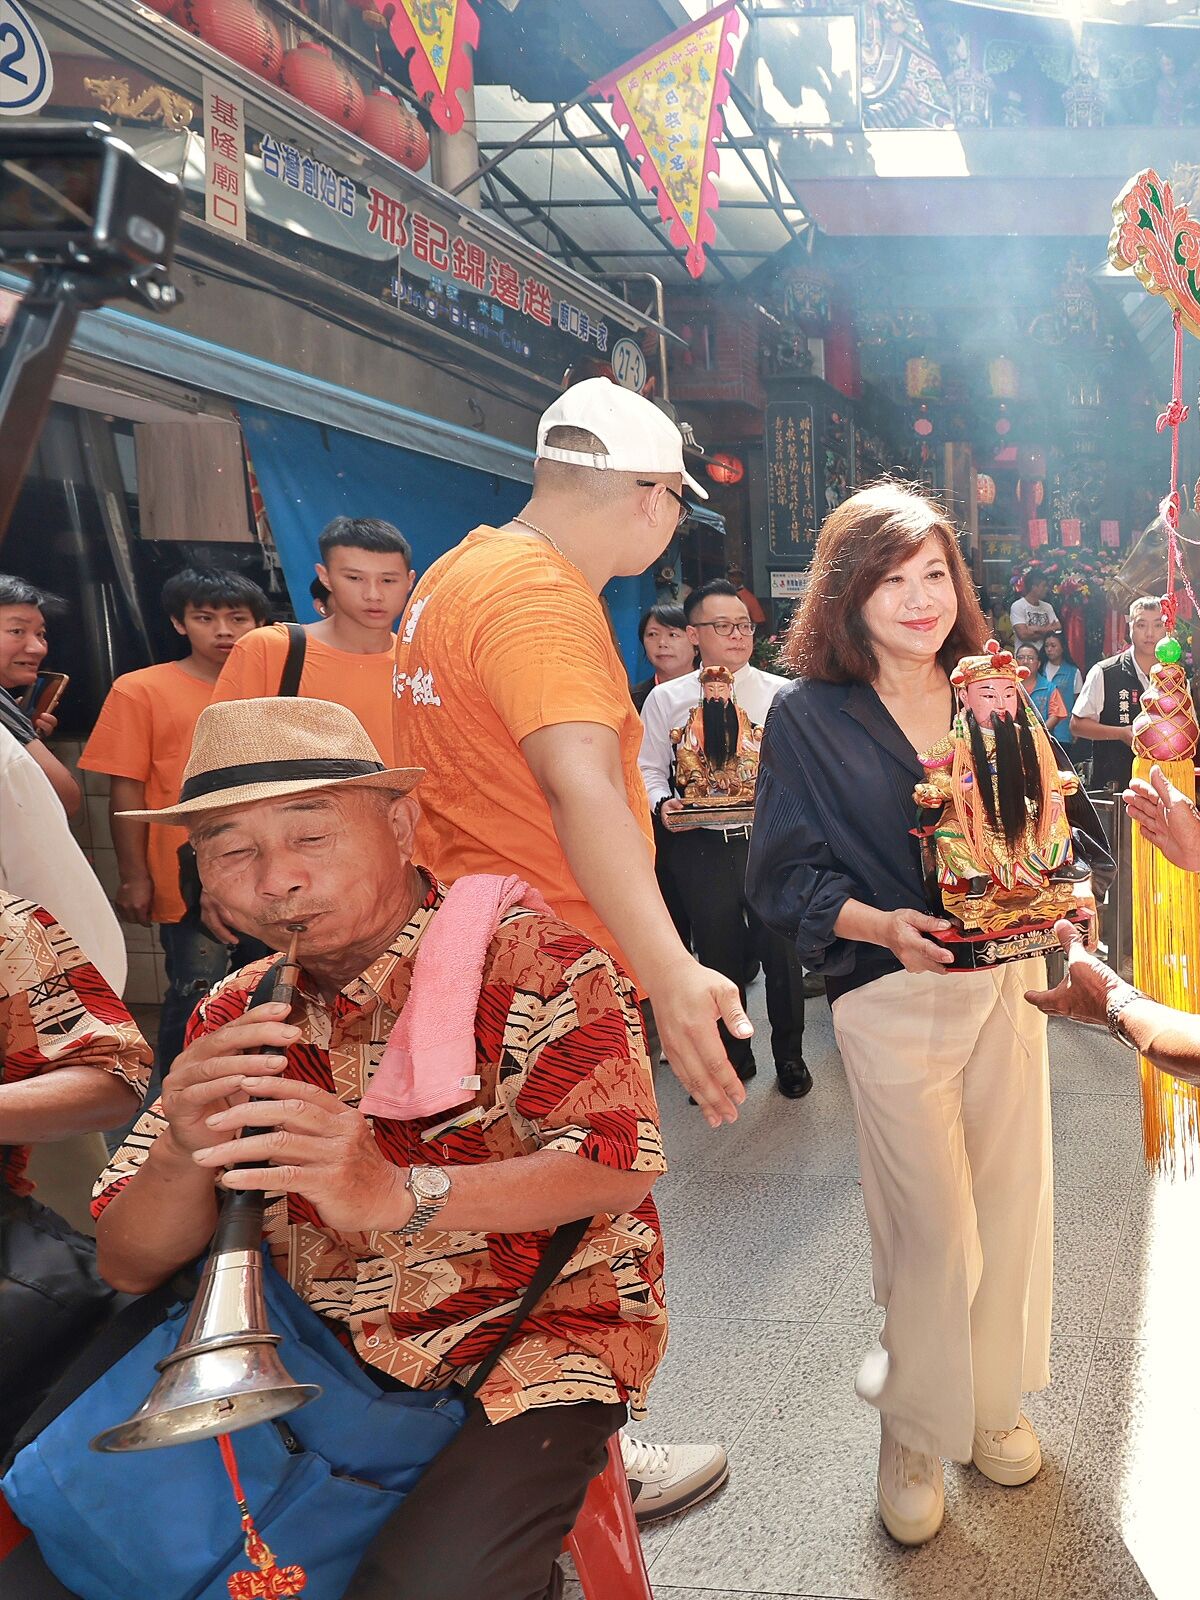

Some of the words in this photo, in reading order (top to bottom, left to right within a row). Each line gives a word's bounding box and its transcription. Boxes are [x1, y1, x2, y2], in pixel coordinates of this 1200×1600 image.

[210, 93, 239, 227] 基隆廟口
[260, 134, 355, 217] 台灣創始店
[558, 299, 609, 353] 廟口第一家
[617, 345, 641, 389] 27-3
